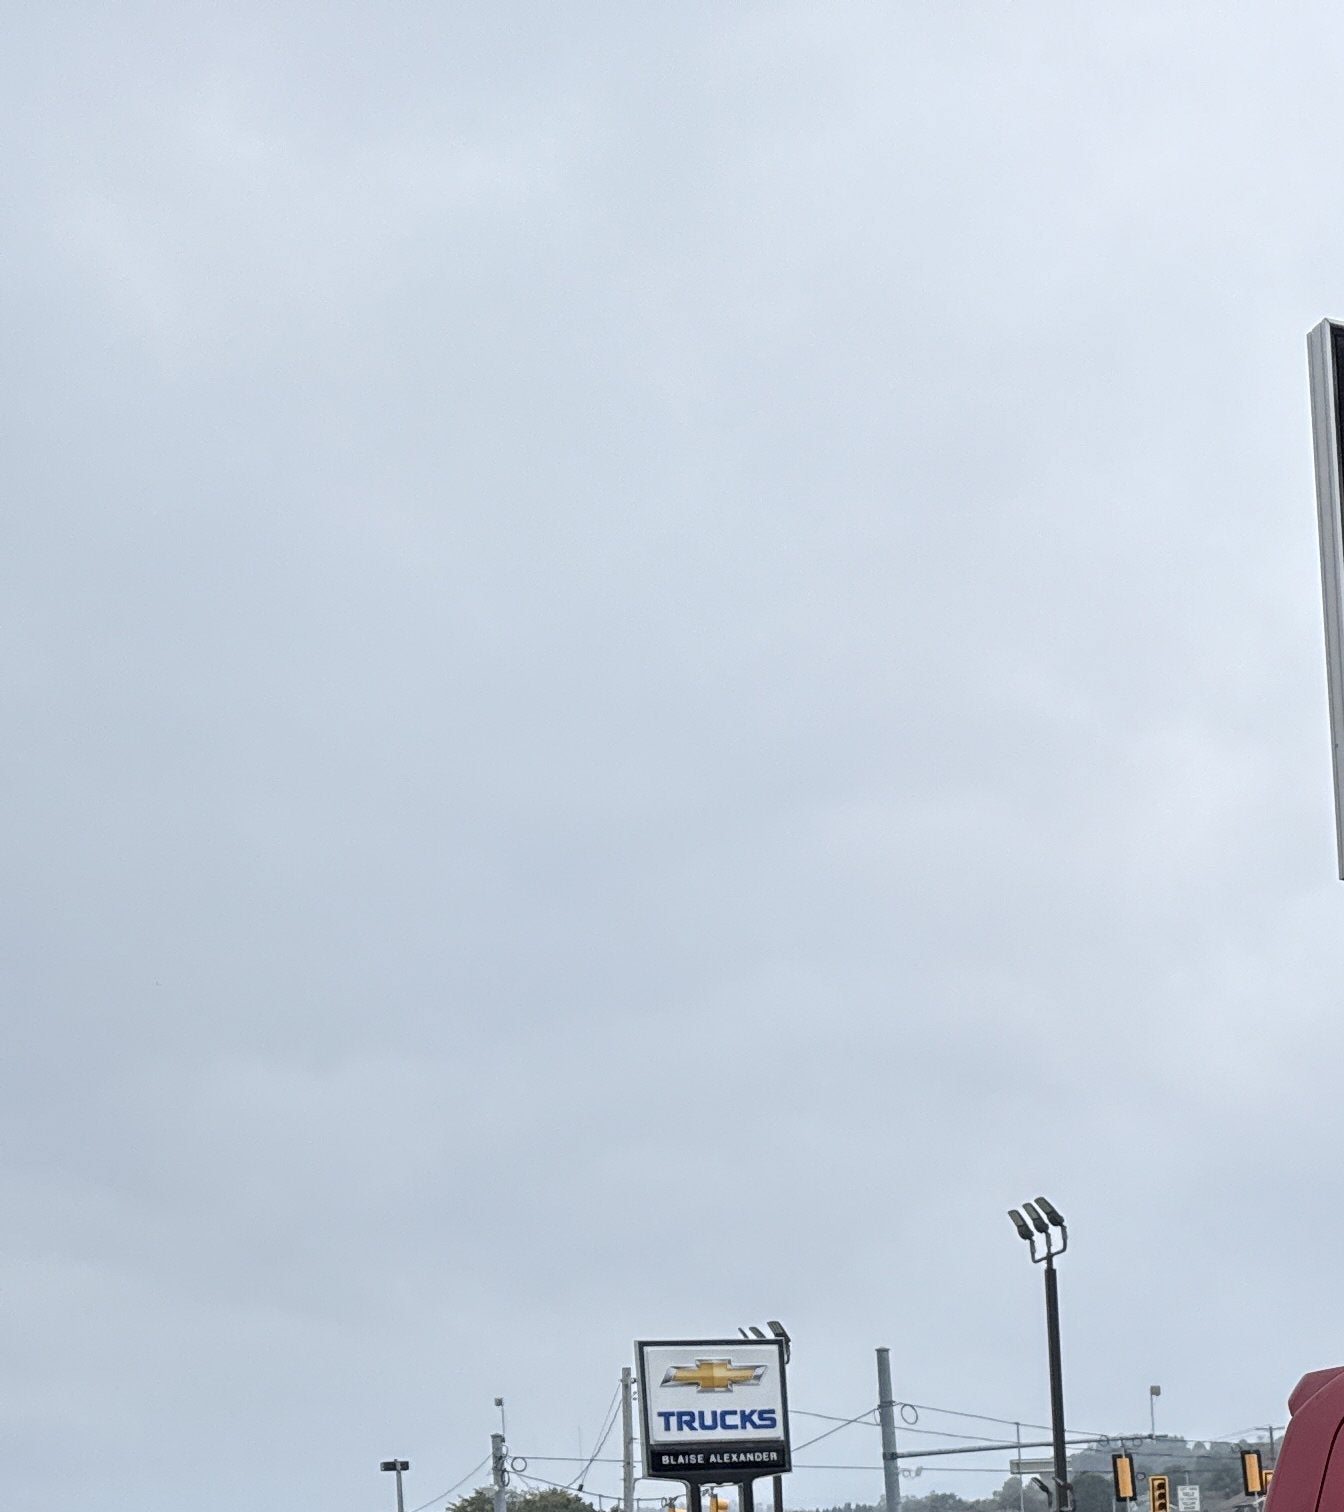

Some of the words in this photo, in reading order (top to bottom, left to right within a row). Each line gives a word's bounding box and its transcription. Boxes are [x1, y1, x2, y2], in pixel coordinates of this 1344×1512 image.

[657, 1408, 777, 1432] TRUCKS
[661, 1454, 705, 1465] BLAISE
[709, 1451, 778, 1463] ALEXANDER
